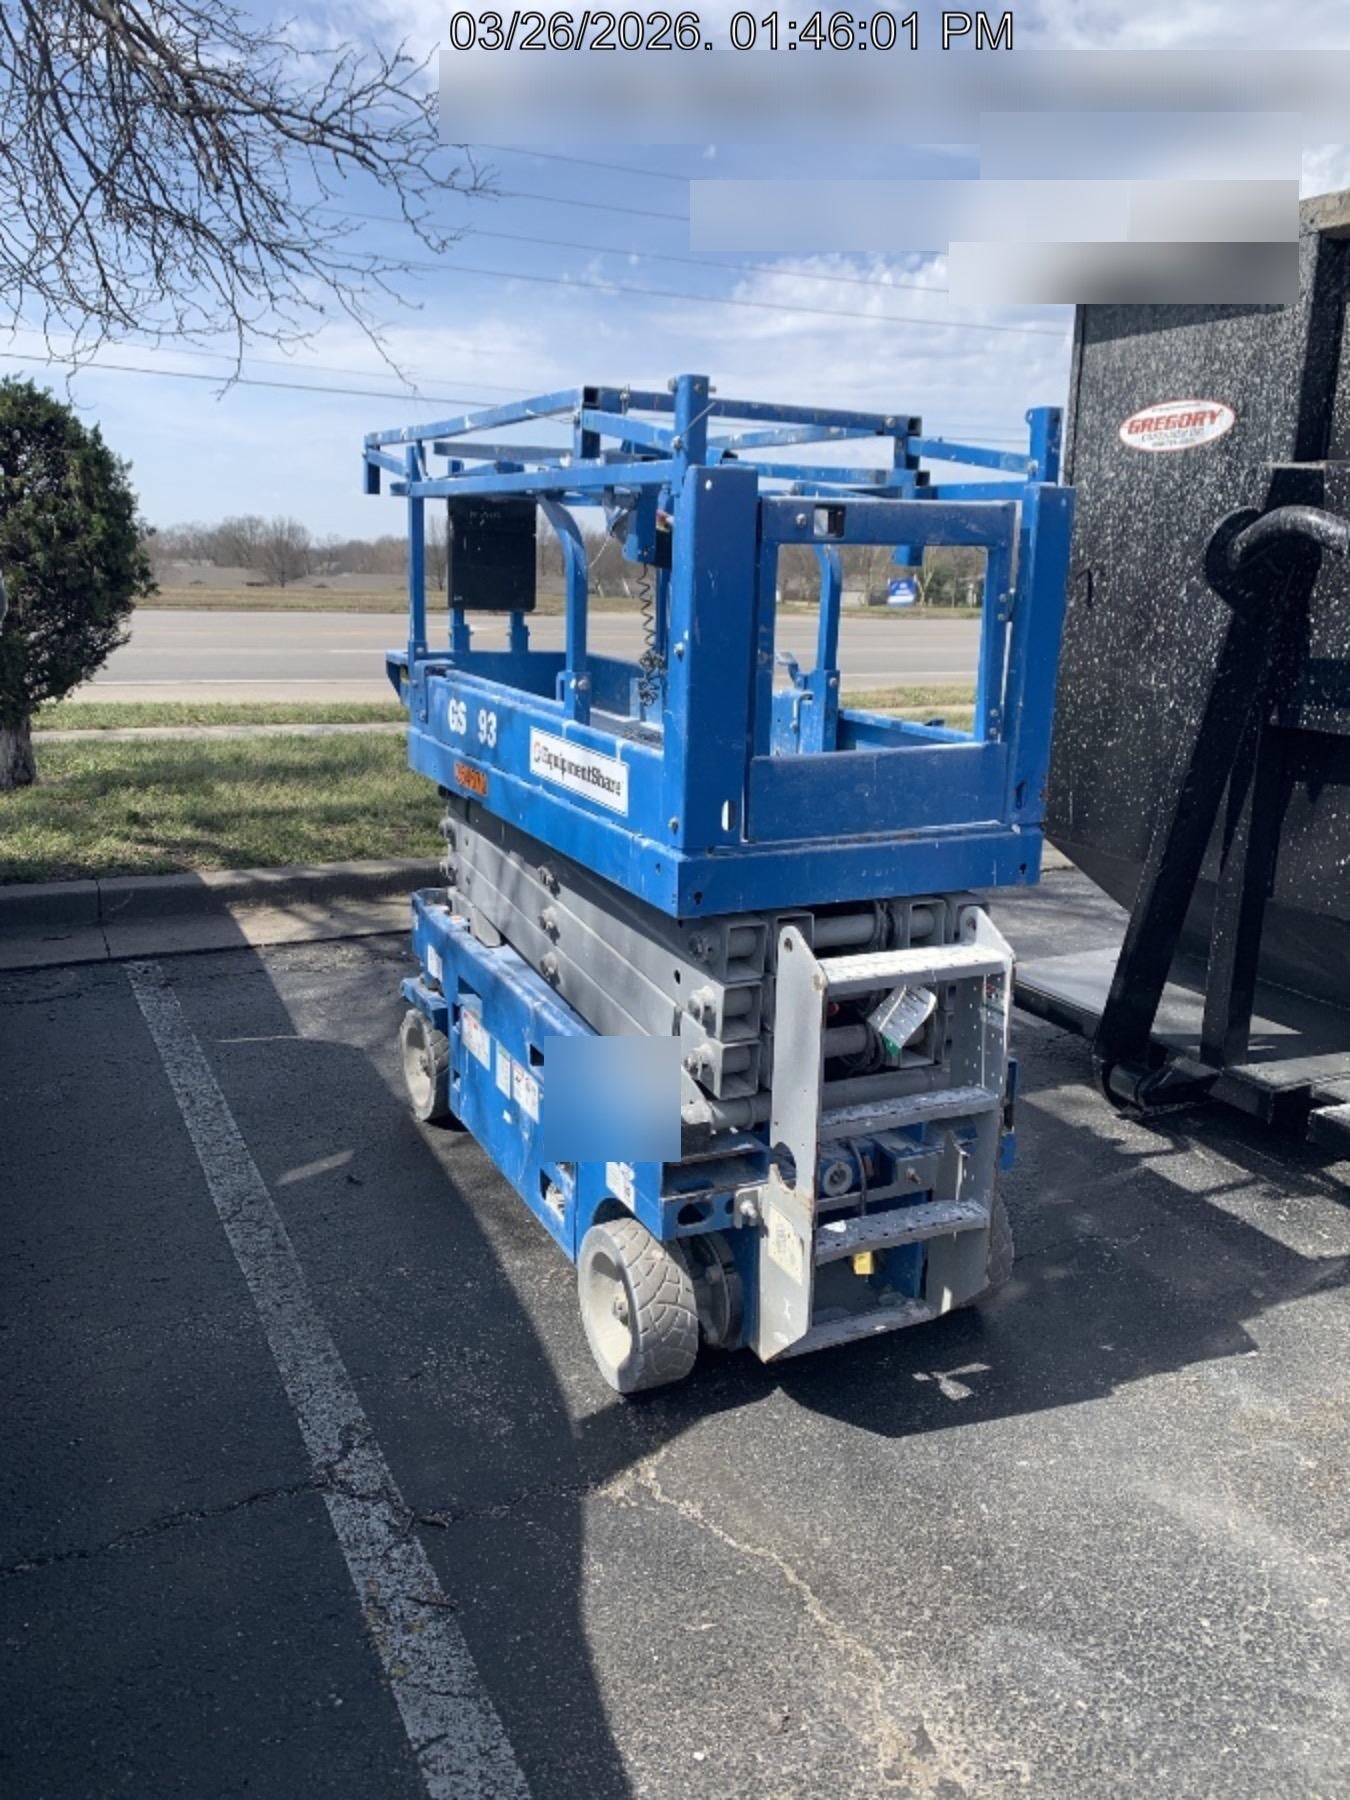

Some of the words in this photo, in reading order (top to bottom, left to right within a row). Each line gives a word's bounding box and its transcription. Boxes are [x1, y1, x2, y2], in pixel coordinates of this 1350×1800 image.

[1127, 408, 1221, 434] GREGORY
[448, 698, 467, 735] GS
[478, 708, 497, 749] 93
